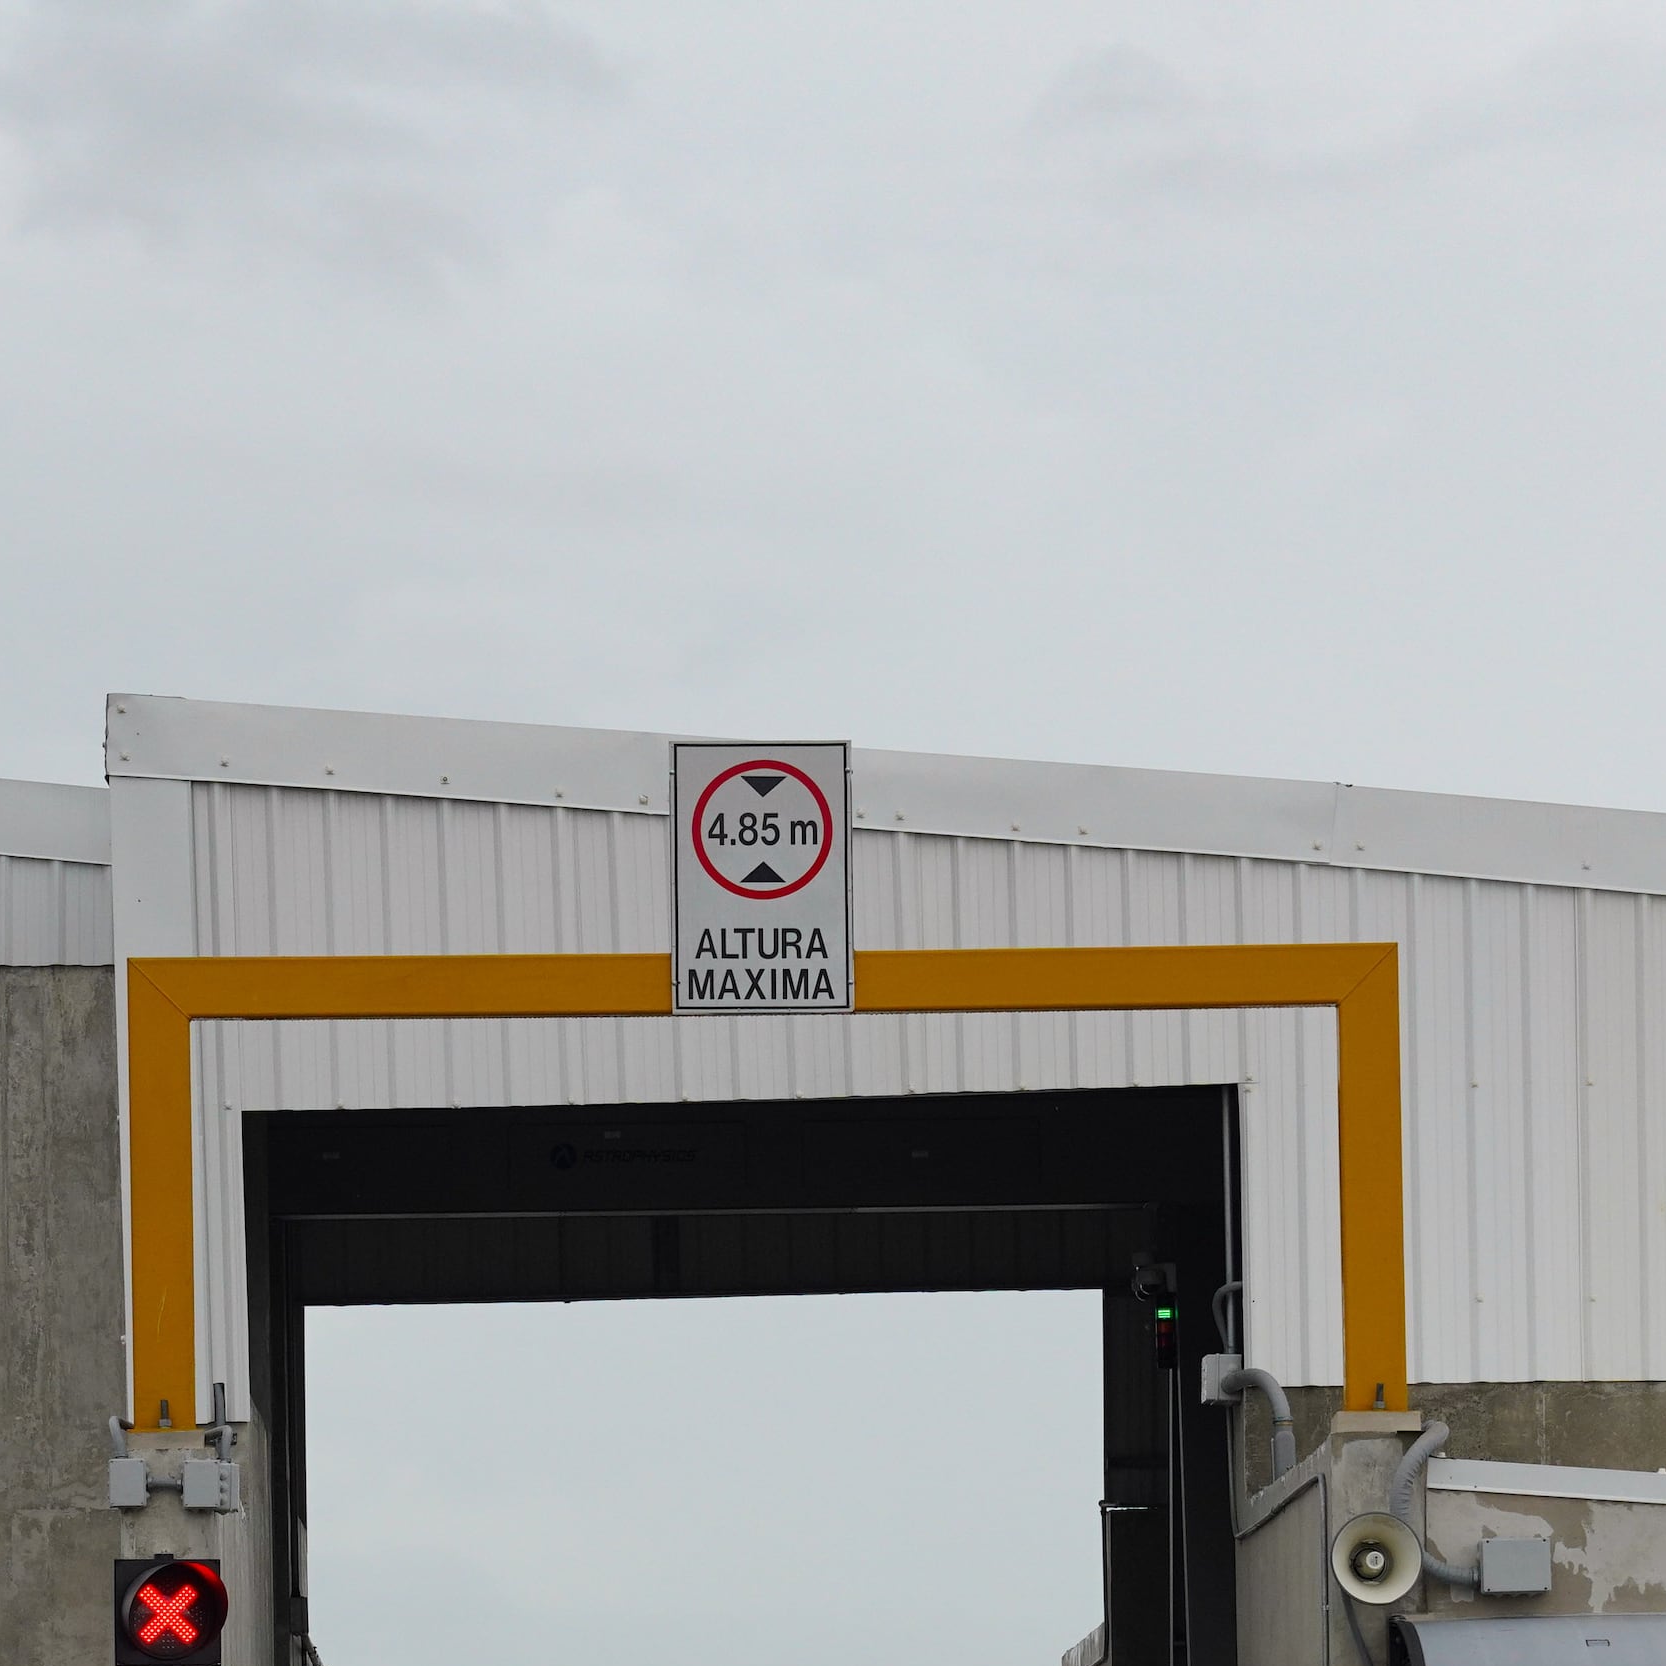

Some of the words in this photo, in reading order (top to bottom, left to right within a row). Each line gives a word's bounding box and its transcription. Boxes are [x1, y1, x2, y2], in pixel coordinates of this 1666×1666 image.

[708, 812, 781, 846] 4.85
[790, 819, 818, 846] m
[695, 927, 829, 960] ALTURA
[688, 968, 835, 1000] MAXIMA
